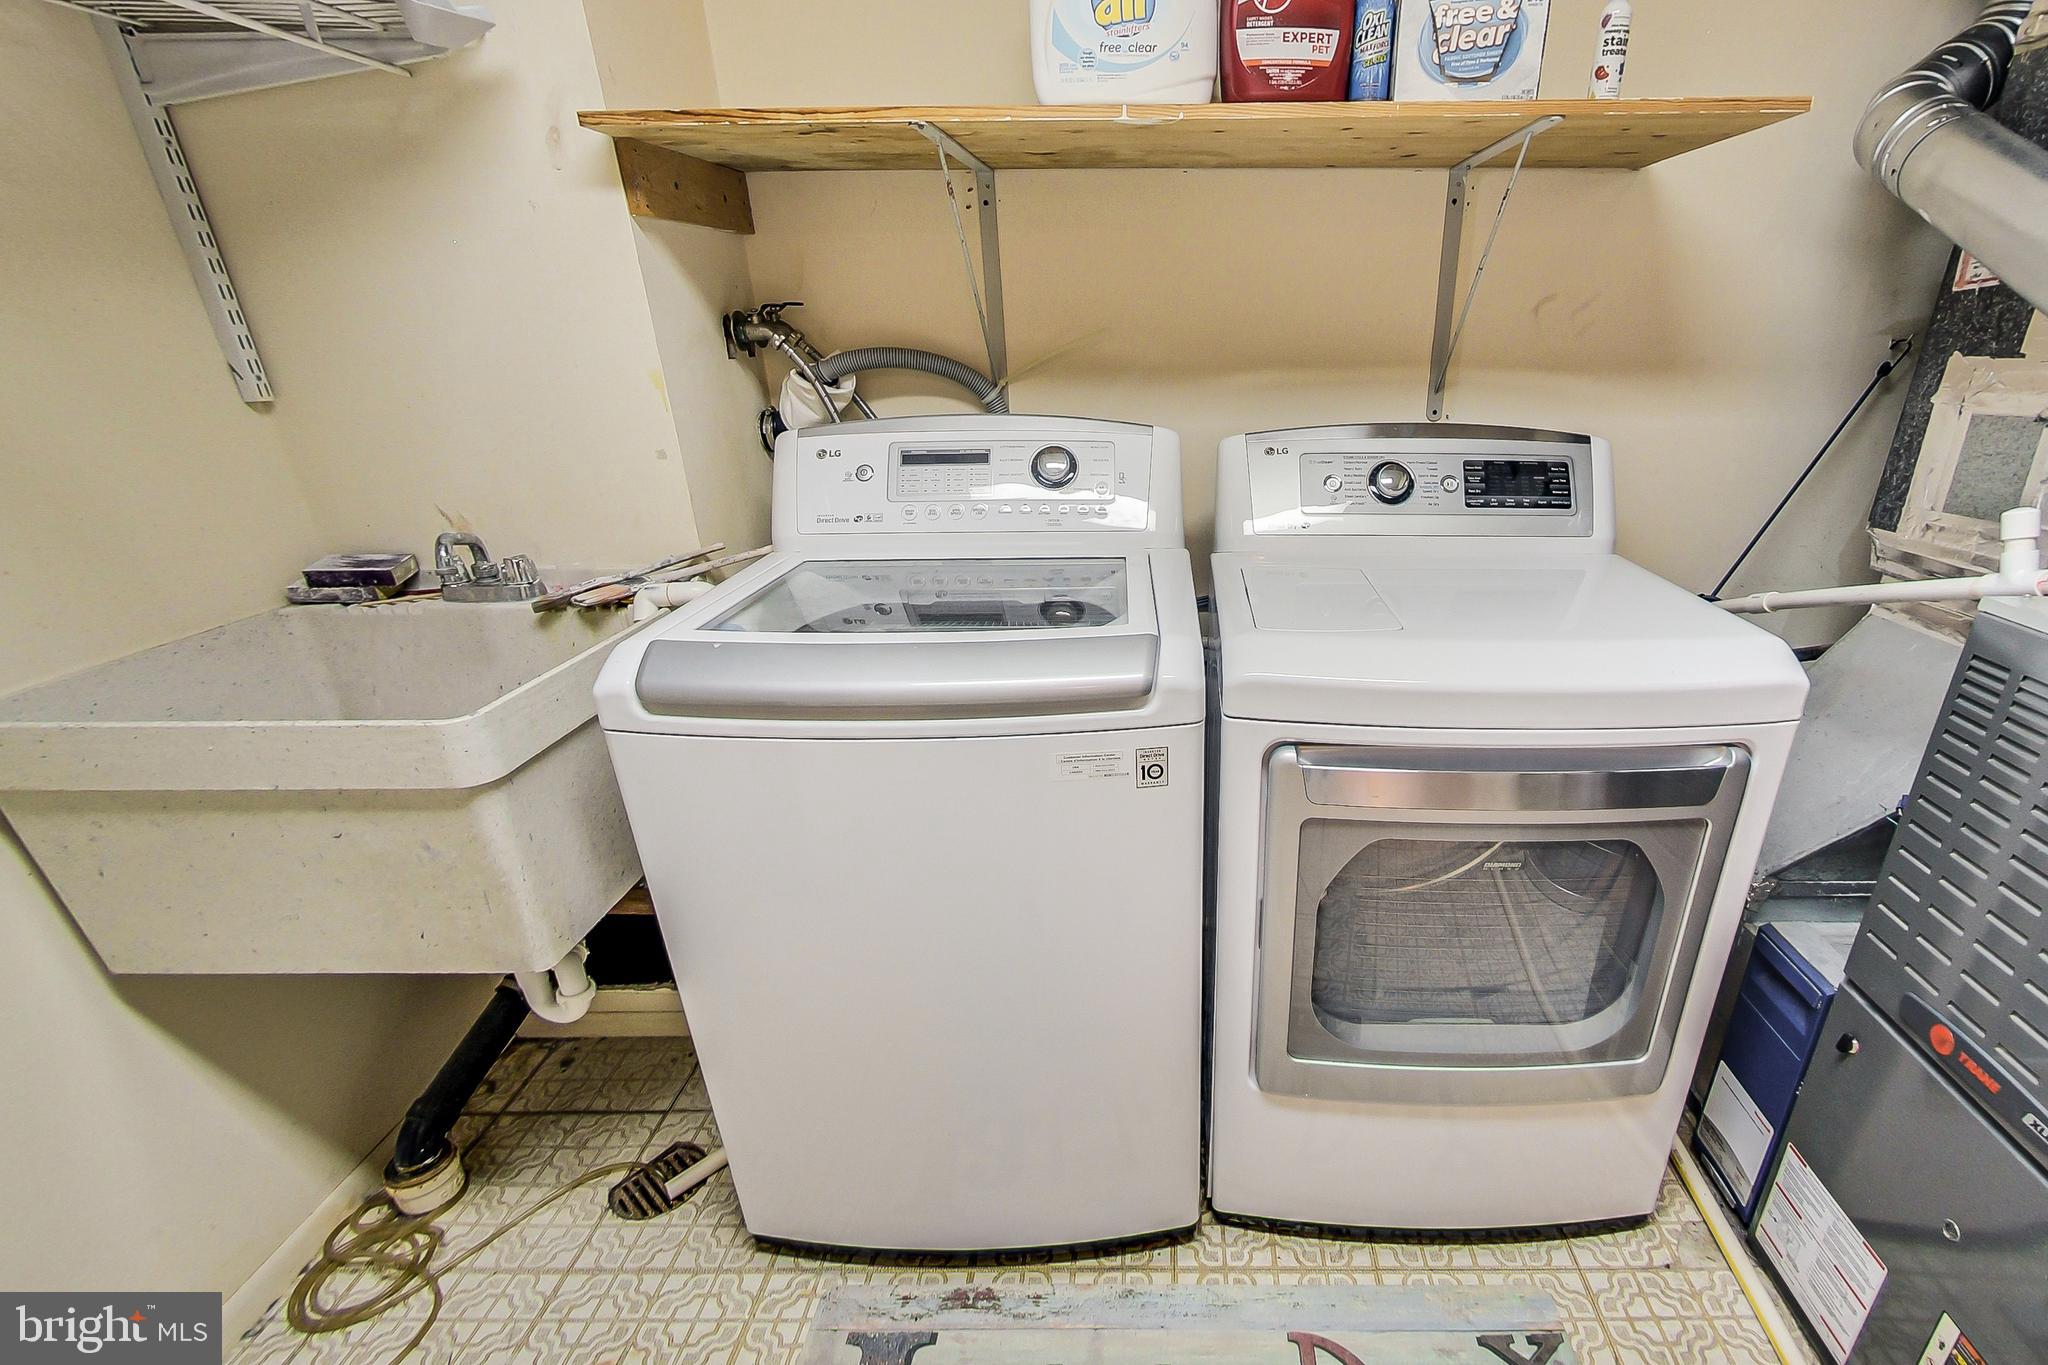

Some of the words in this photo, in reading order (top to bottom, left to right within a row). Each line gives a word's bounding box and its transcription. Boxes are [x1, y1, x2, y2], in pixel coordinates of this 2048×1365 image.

[1364, 11, 1384, 30] OXI
[1435, 5, 1494, 28] free
[1496, 0, 1518, 19] &
[1106, 24, 1150, 37] stainlifters
[1283, 32, 1333, 44] EXPERT
[1356, 21, 1390, 47] CLEAN
[1436, 24, 1515, 54] clear
[1100, 42, 1121, 53] free
[1128, 42, 1158, 53] clear
[1312, 46, 1330, 54] PET
[1141, 764, 1163, 780] 10
[1958, 1050, 2001, 1095] TRANE
